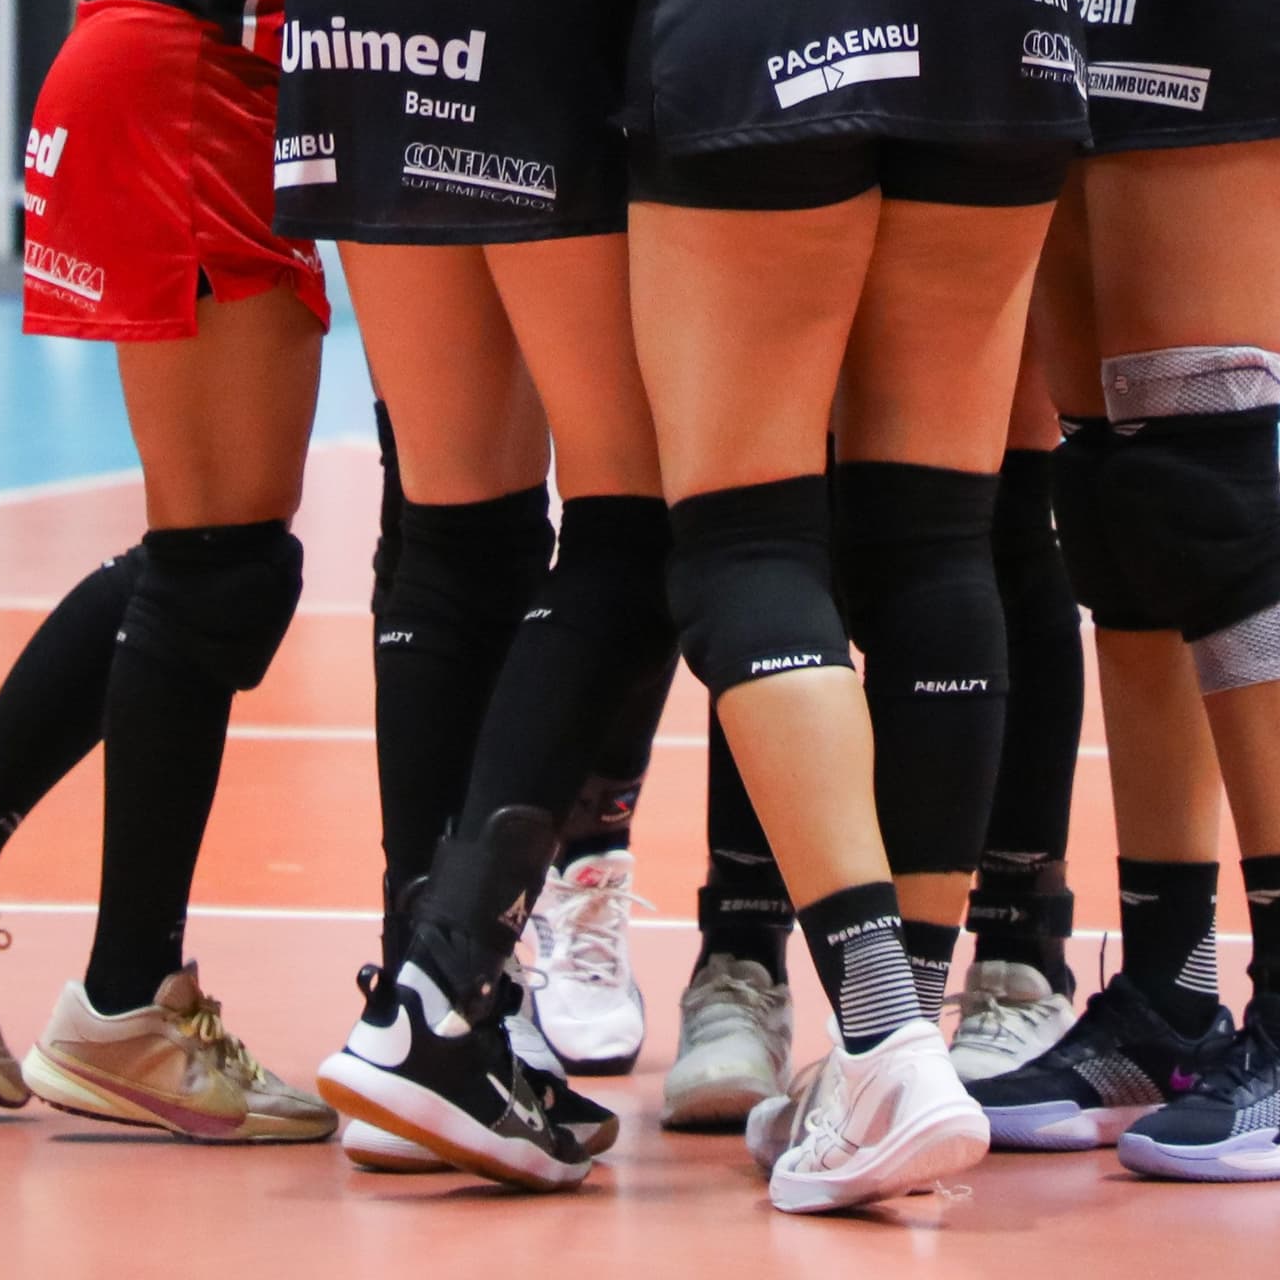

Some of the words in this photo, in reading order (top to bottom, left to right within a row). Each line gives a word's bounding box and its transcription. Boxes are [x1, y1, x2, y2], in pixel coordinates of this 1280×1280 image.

[281, 16, 486, 82] Unimed
[767, 23, 919, 81] PACAEMBU
[405, 90, 476, 122] Bauru
[401, 176, 554, 211] SUPERMERCADOS
[751, 653, 822, 674] PENALTY
[914, 679, 988, 693] PENALTY
[827, 916, 902, 946] PENALTY
